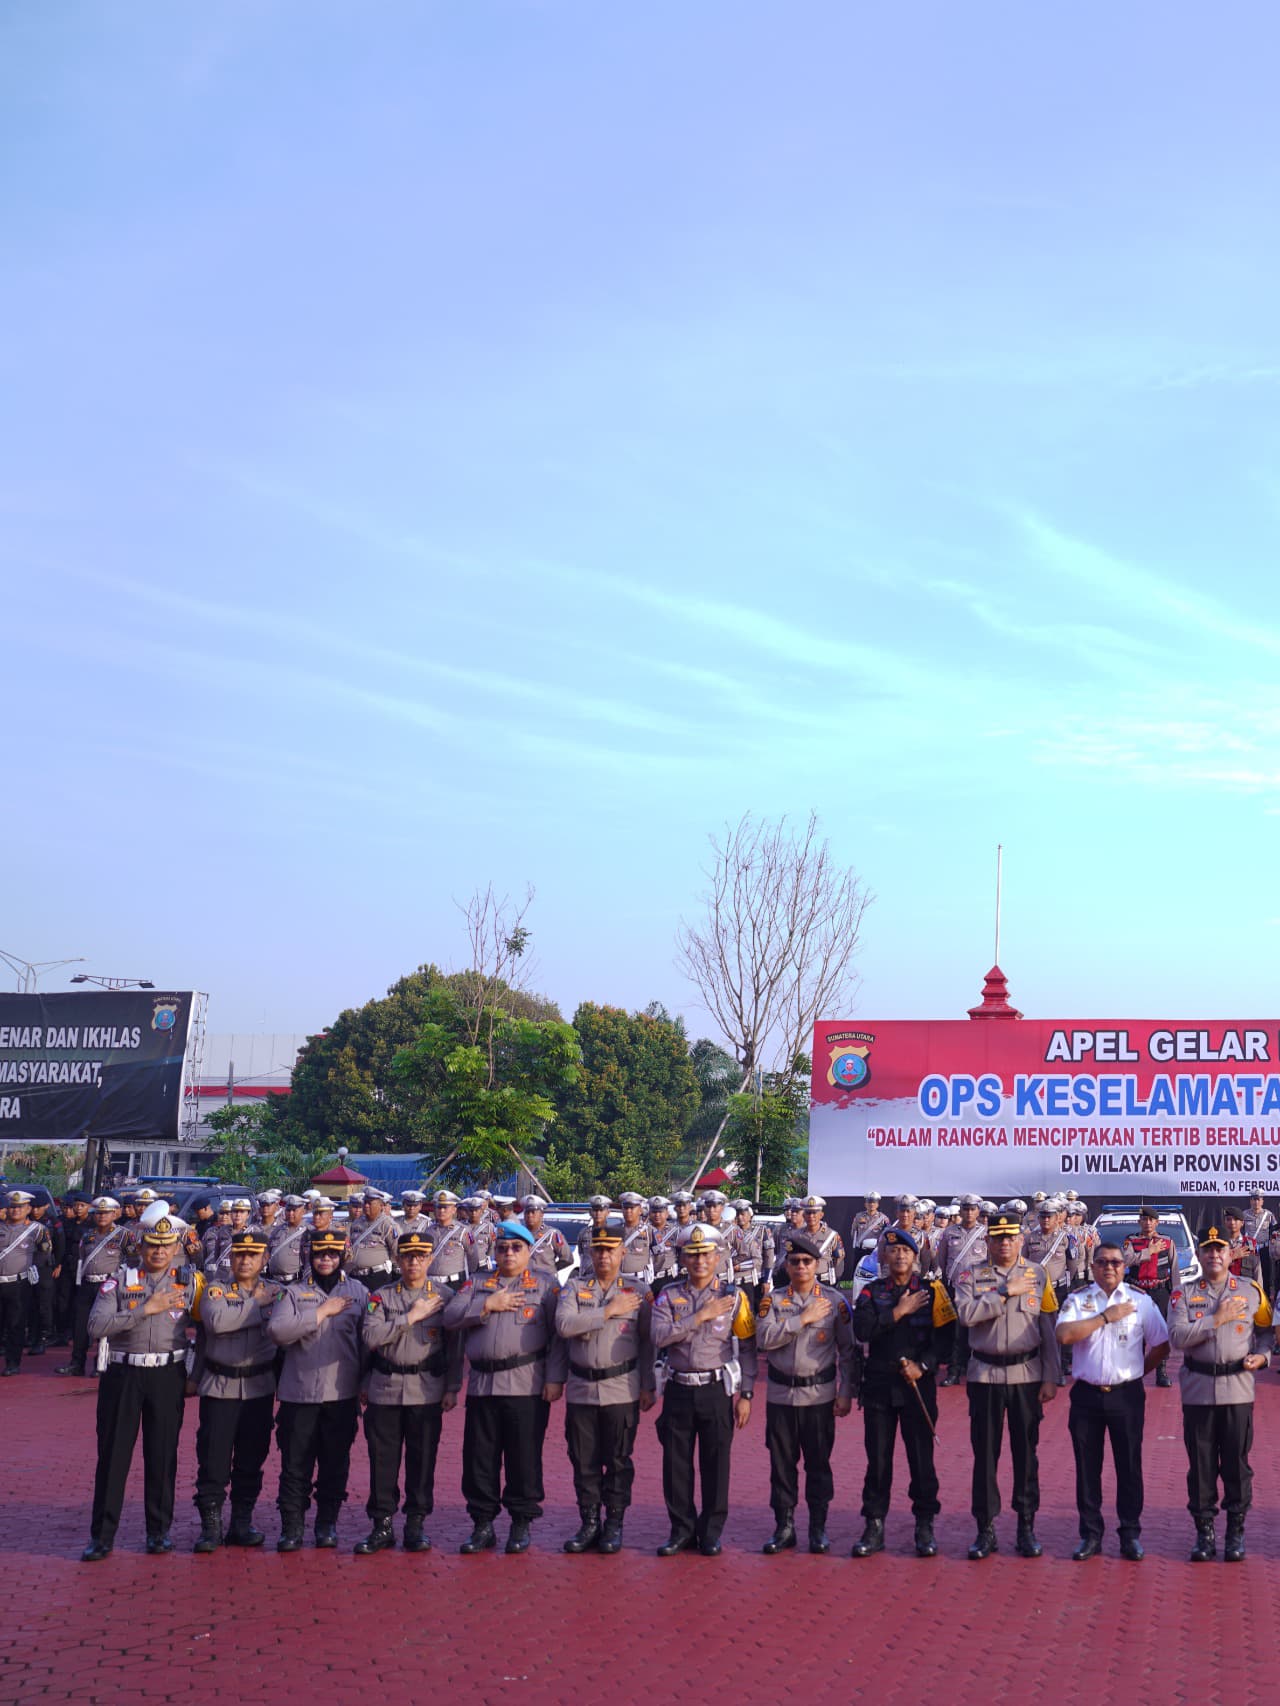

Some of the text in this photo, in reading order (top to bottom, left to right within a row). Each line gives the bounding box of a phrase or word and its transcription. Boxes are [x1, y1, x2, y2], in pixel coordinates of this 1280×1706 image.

[46, 1027, 78, 1048] DAN
[83, 1026, 141, 1048] IKHLAS
[827, 1033, 874, 1042] SUMATERA UTARA
[1045, 1032, 1138, 1060] APEL
[1149, 1031, 1269, 1061] GELAR
[921, 1077, 1001, 1117] OPS
[867, 1128, 932, 1147] “DALAM
[938, 1127, 1008, 1147] RANGKA
[1014, 1127, 1135, 1147] MENCIPTAKAN
[1141, 1127, 1201, 1147] TERTIB
[1206, 1127, 1280, 1146] BERLALU
[1061, 1154, 1079, 1173] DI
[1085, 1154, 1167, 1173] WILAYAH
[1173, 1154, 1260, 1172] PROVINSI
[1180, 1181, 1220, 1194] MEDAN,
[1223, 1181, 1236, 1192] 10
